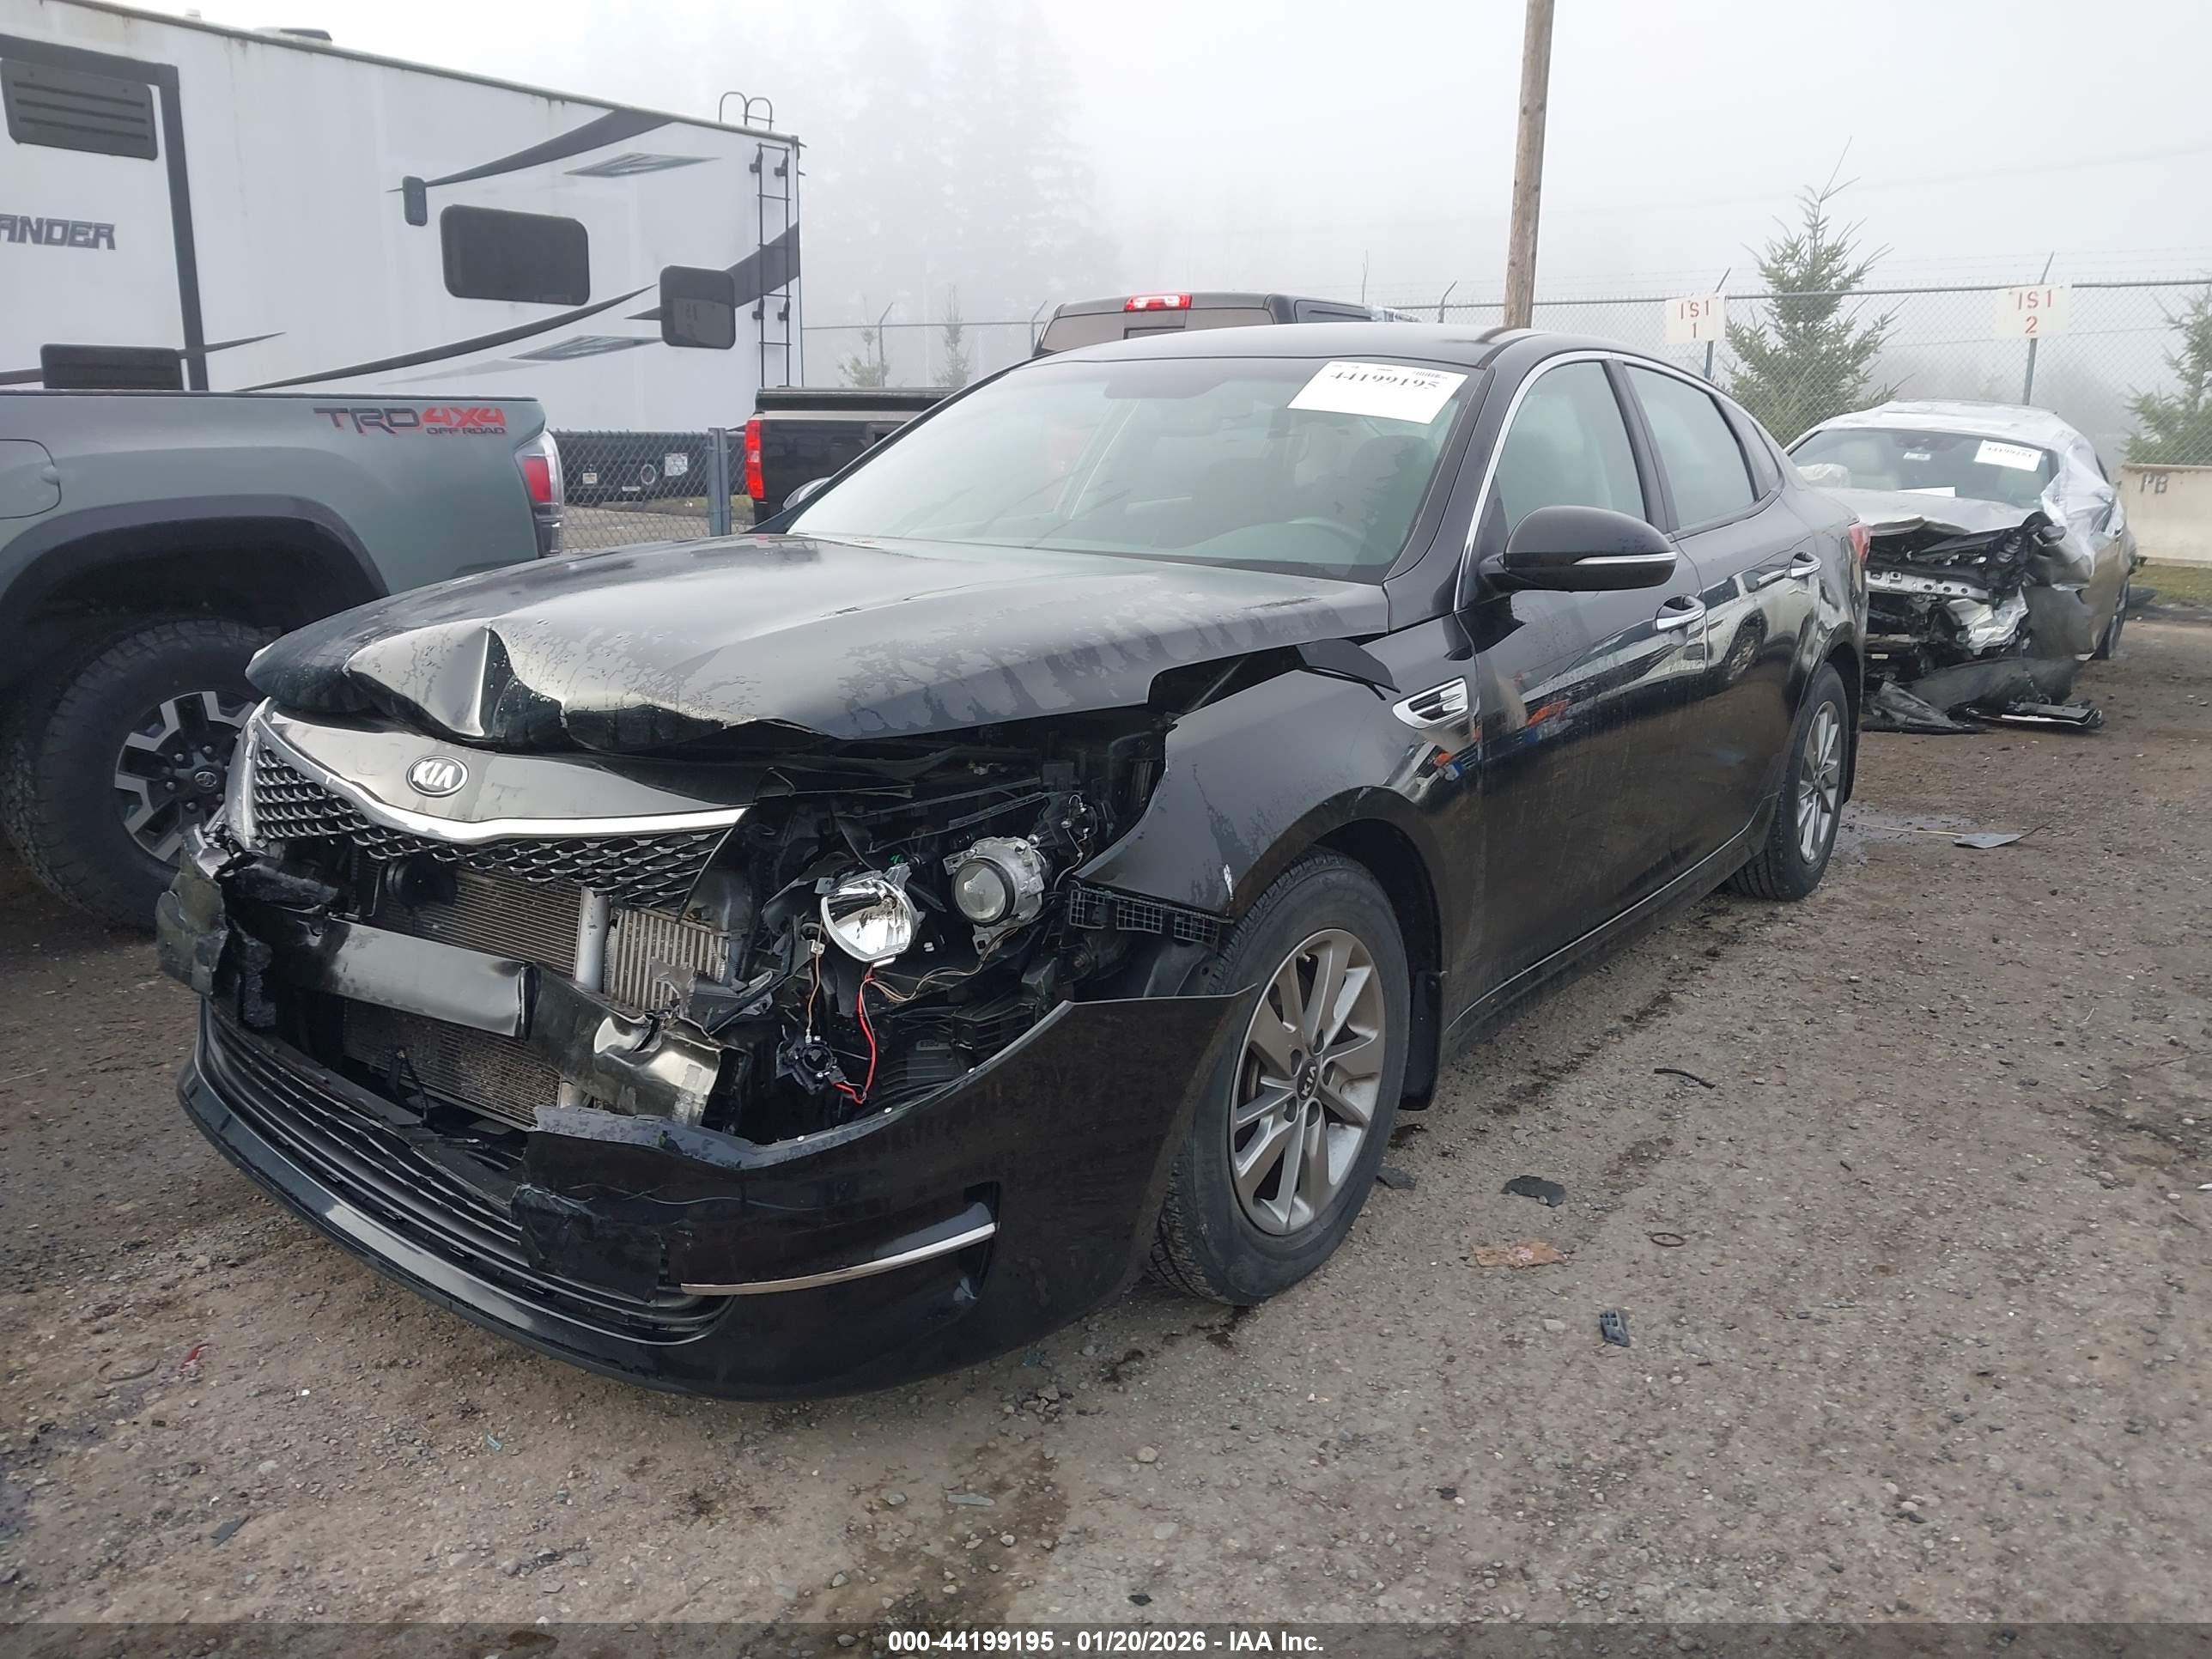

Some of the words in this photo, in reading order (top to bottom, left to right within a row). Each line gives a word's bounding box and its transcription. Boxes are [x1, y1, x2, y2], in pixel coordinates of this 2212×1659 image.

[2025, 315, 2039, 334] 2
[1330, 370, 1442, 390] 44199195
[313, 407, 420, 434] TRD
[426, 426, 461, 434] OFF
[462, 426, 507, 434] ROAD
[2140, 473, 2170, 494] PB
[412, 761, 455, 789] KIA
[1301, 1066, 1316, 1097] KIA
